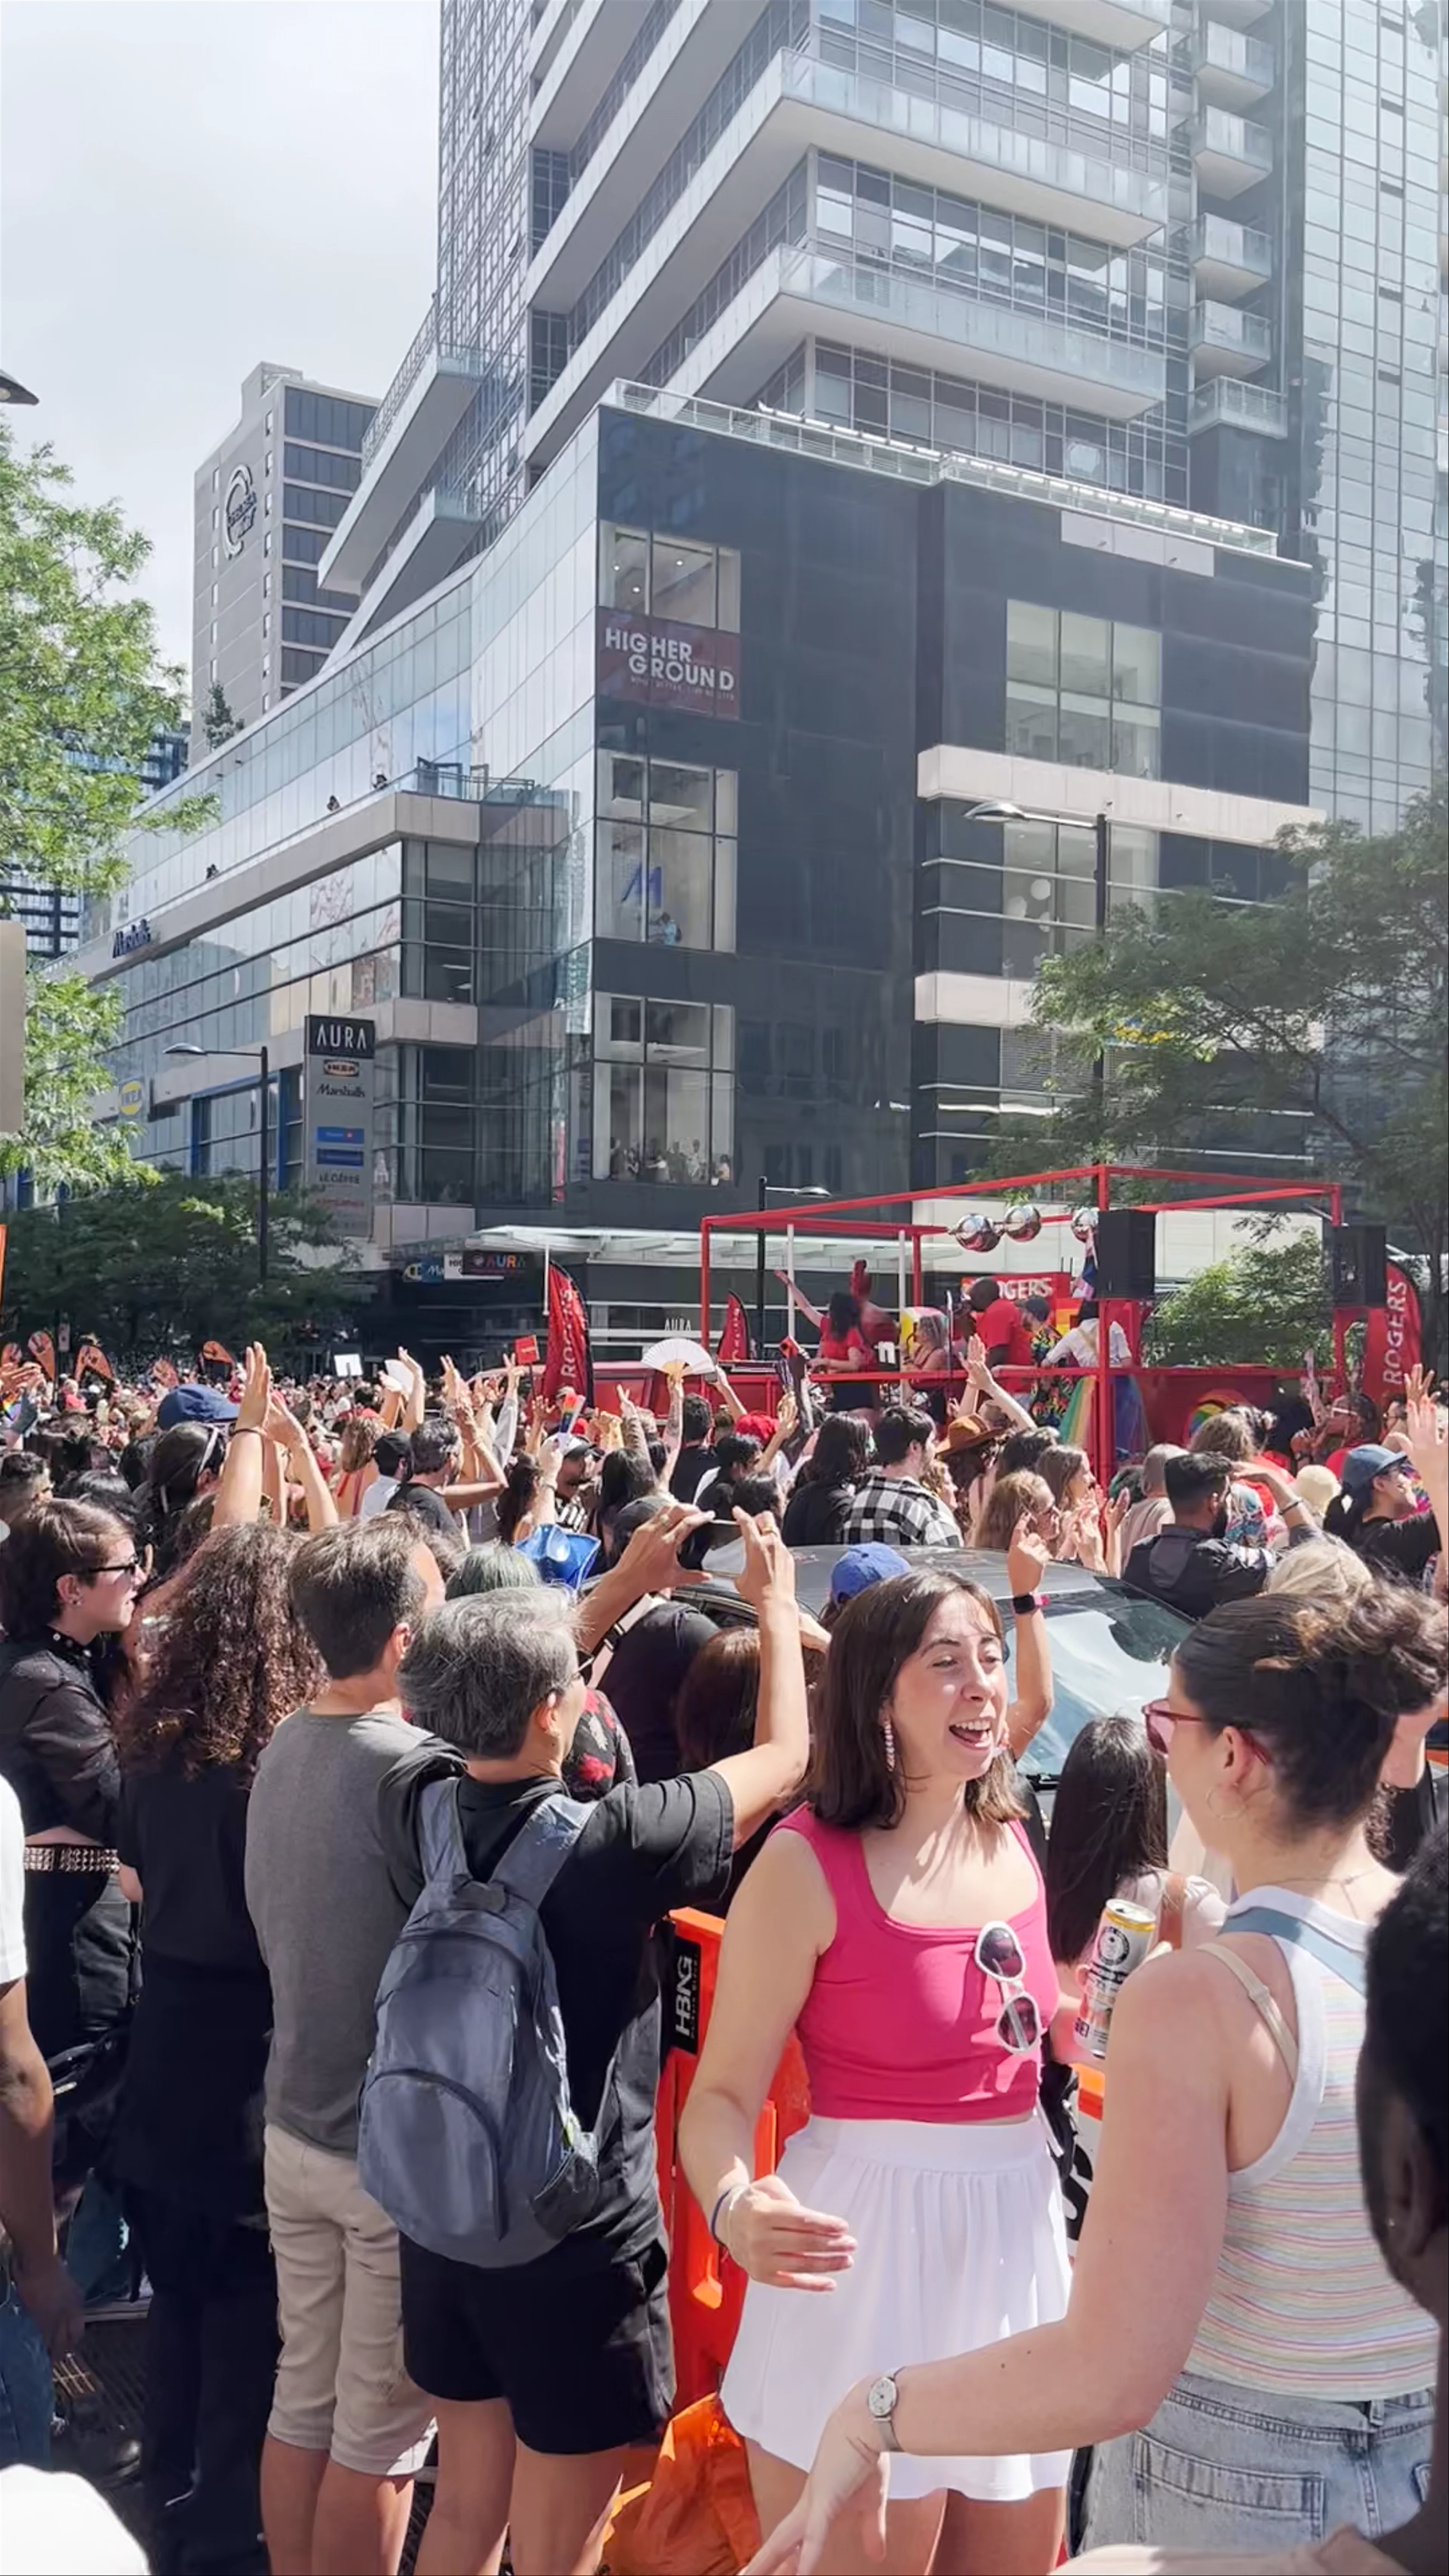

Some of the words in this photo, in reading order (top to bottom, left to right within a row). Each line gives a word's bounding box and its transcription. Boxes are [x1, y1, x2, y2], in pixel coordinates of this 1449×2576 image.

[605, 627, 692, 663] HIGHER
[629, 654, 734, 691] GROUND
[317, 1023, 366, 1050] AURA
[486, 1255, 526, 1268] AURA
[997, 1277, 1053, 1300] GERS
[1382, 1280, 1407, 1385] ROGERS
